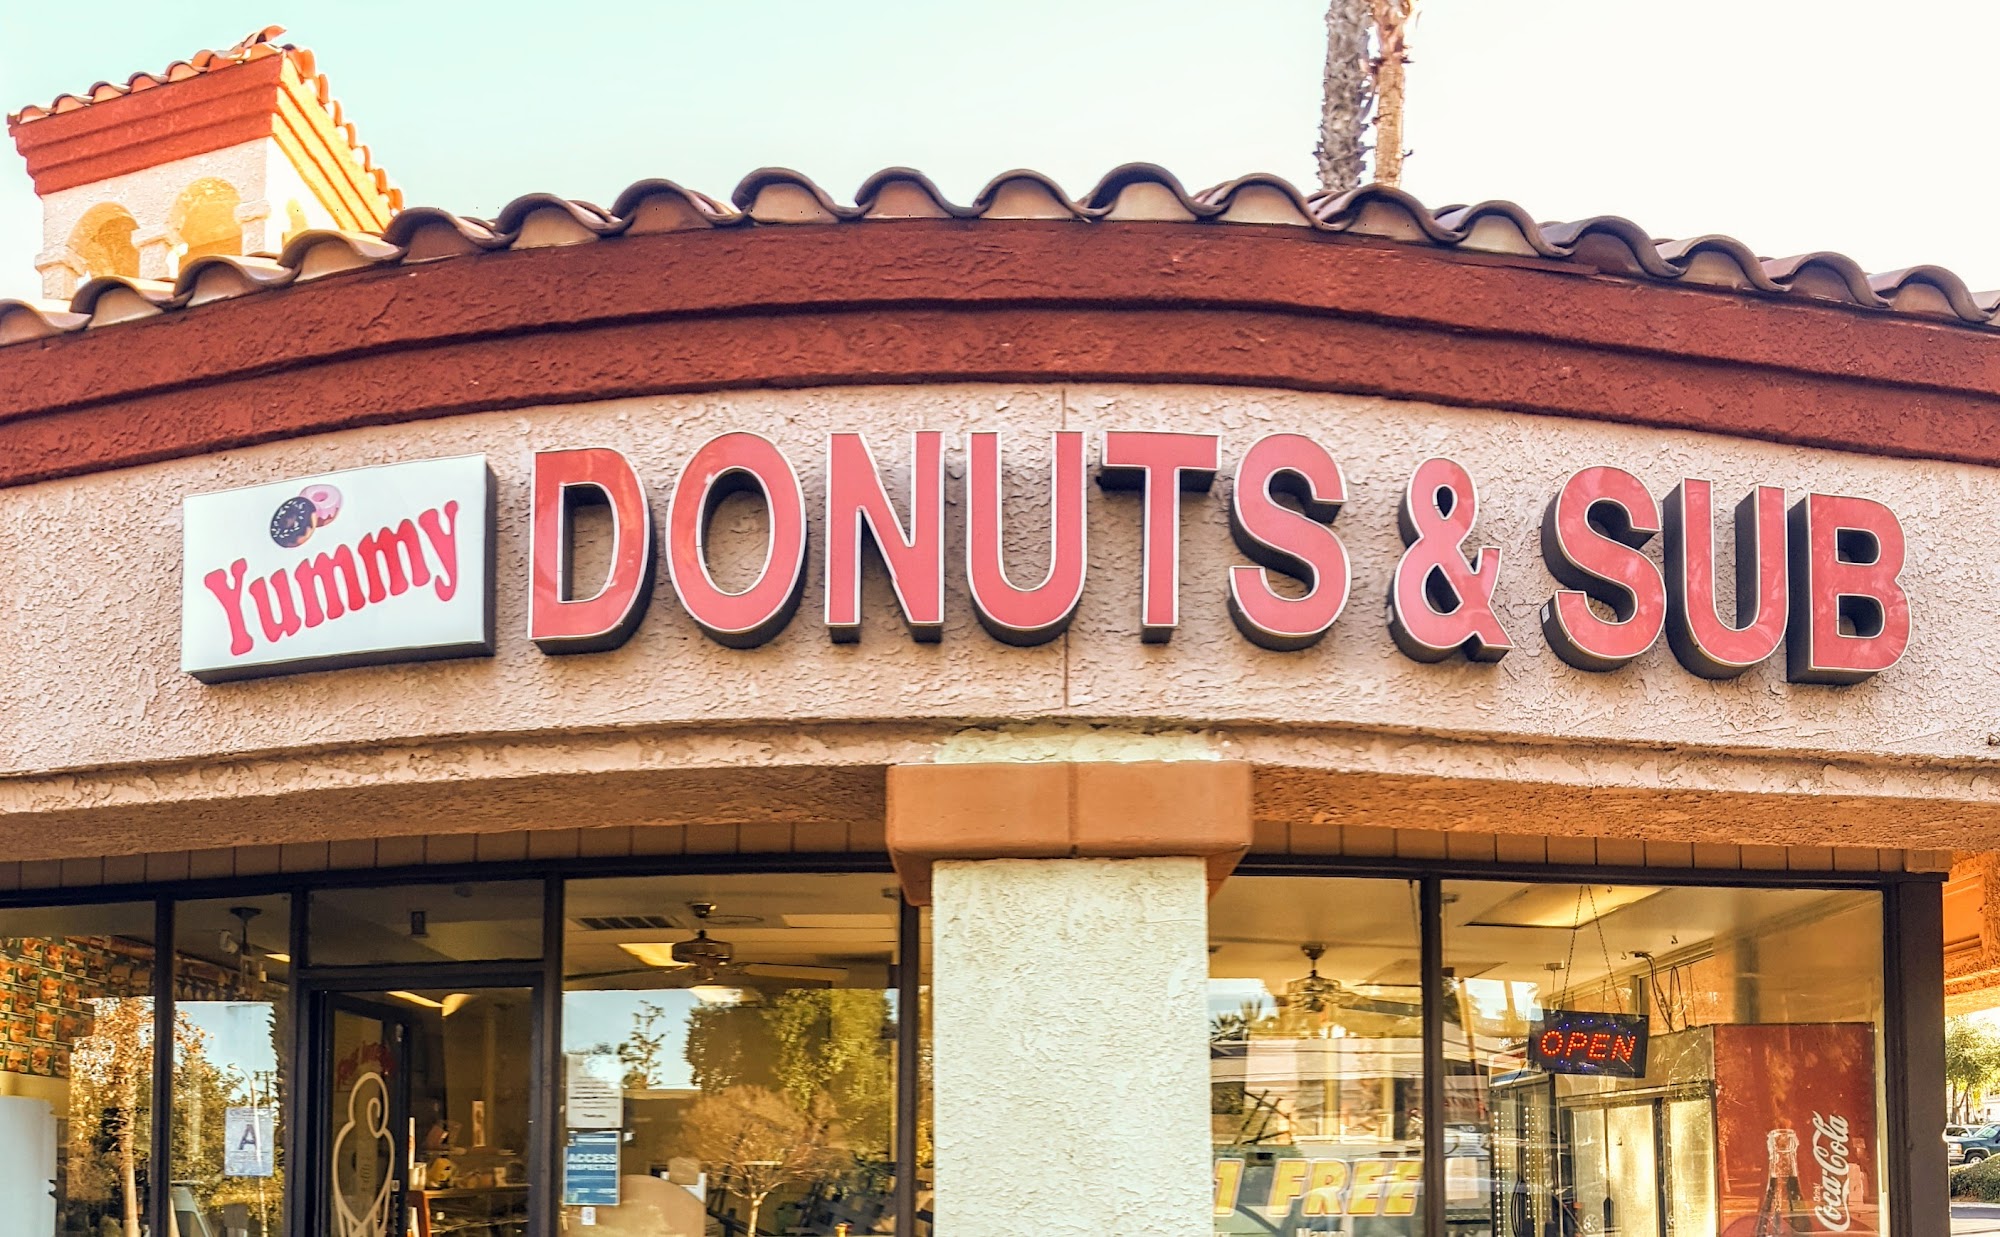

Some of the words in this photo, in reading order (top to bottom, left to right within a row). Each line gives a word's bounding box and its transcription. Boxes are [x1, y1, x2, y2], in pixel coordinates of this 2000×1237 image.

[204, 499, 459, 657] Yummy
[528, 430, 1351, 642] DONUTS
[1394, 456, 1515, 649] &
[1553, 464, 1912, 673] SUB
[1540, 1029, 1637, 1060] OPEN
[238, 1123, 259, 1156] A
[568, 1153, 618, 1164] ACCESS
[1268, 1158, 1422, 1217] FREE
[1812, 1110, 1850, 1233] Coca-Cola
